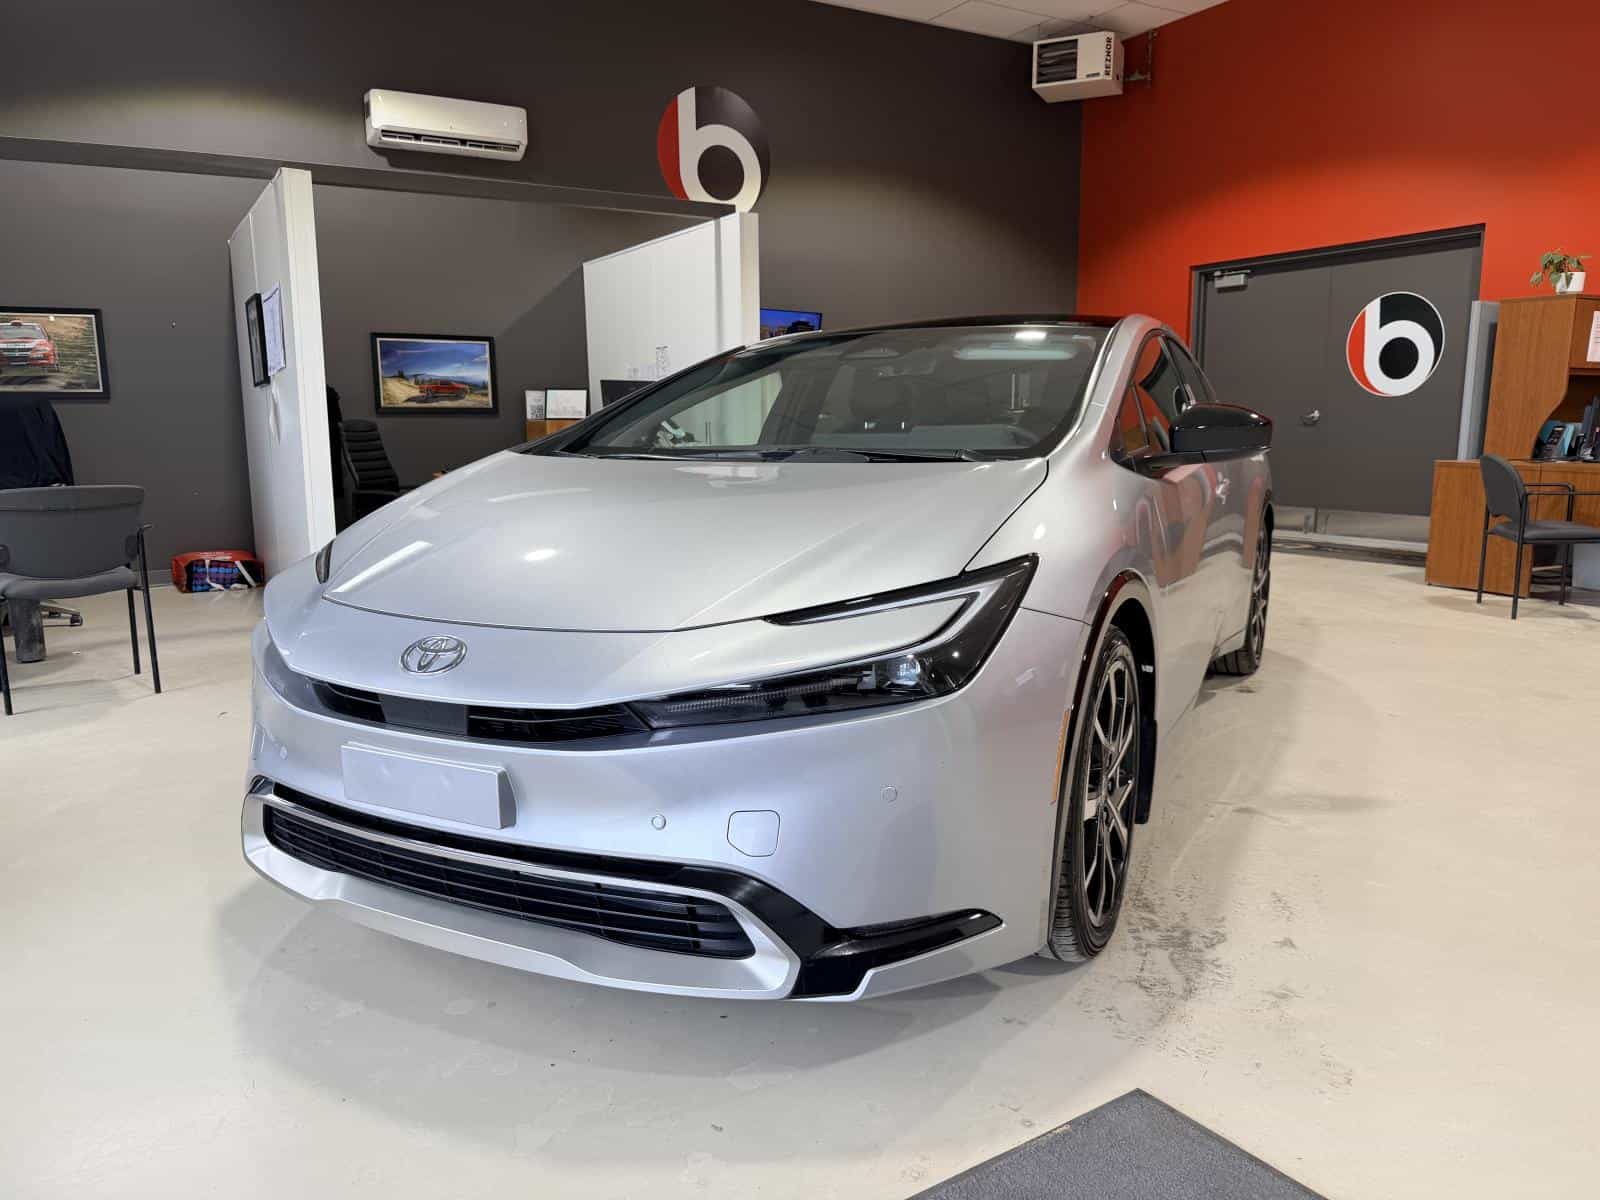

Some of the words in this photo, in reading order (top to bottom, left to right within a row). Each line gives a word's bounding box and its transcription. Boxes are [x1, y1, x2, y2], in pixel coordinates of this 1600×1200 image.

[1104, 36, 1112, 76] REZNOR
[677, 86, 762, 212] b
[1363, 296, 1436, 397] b
